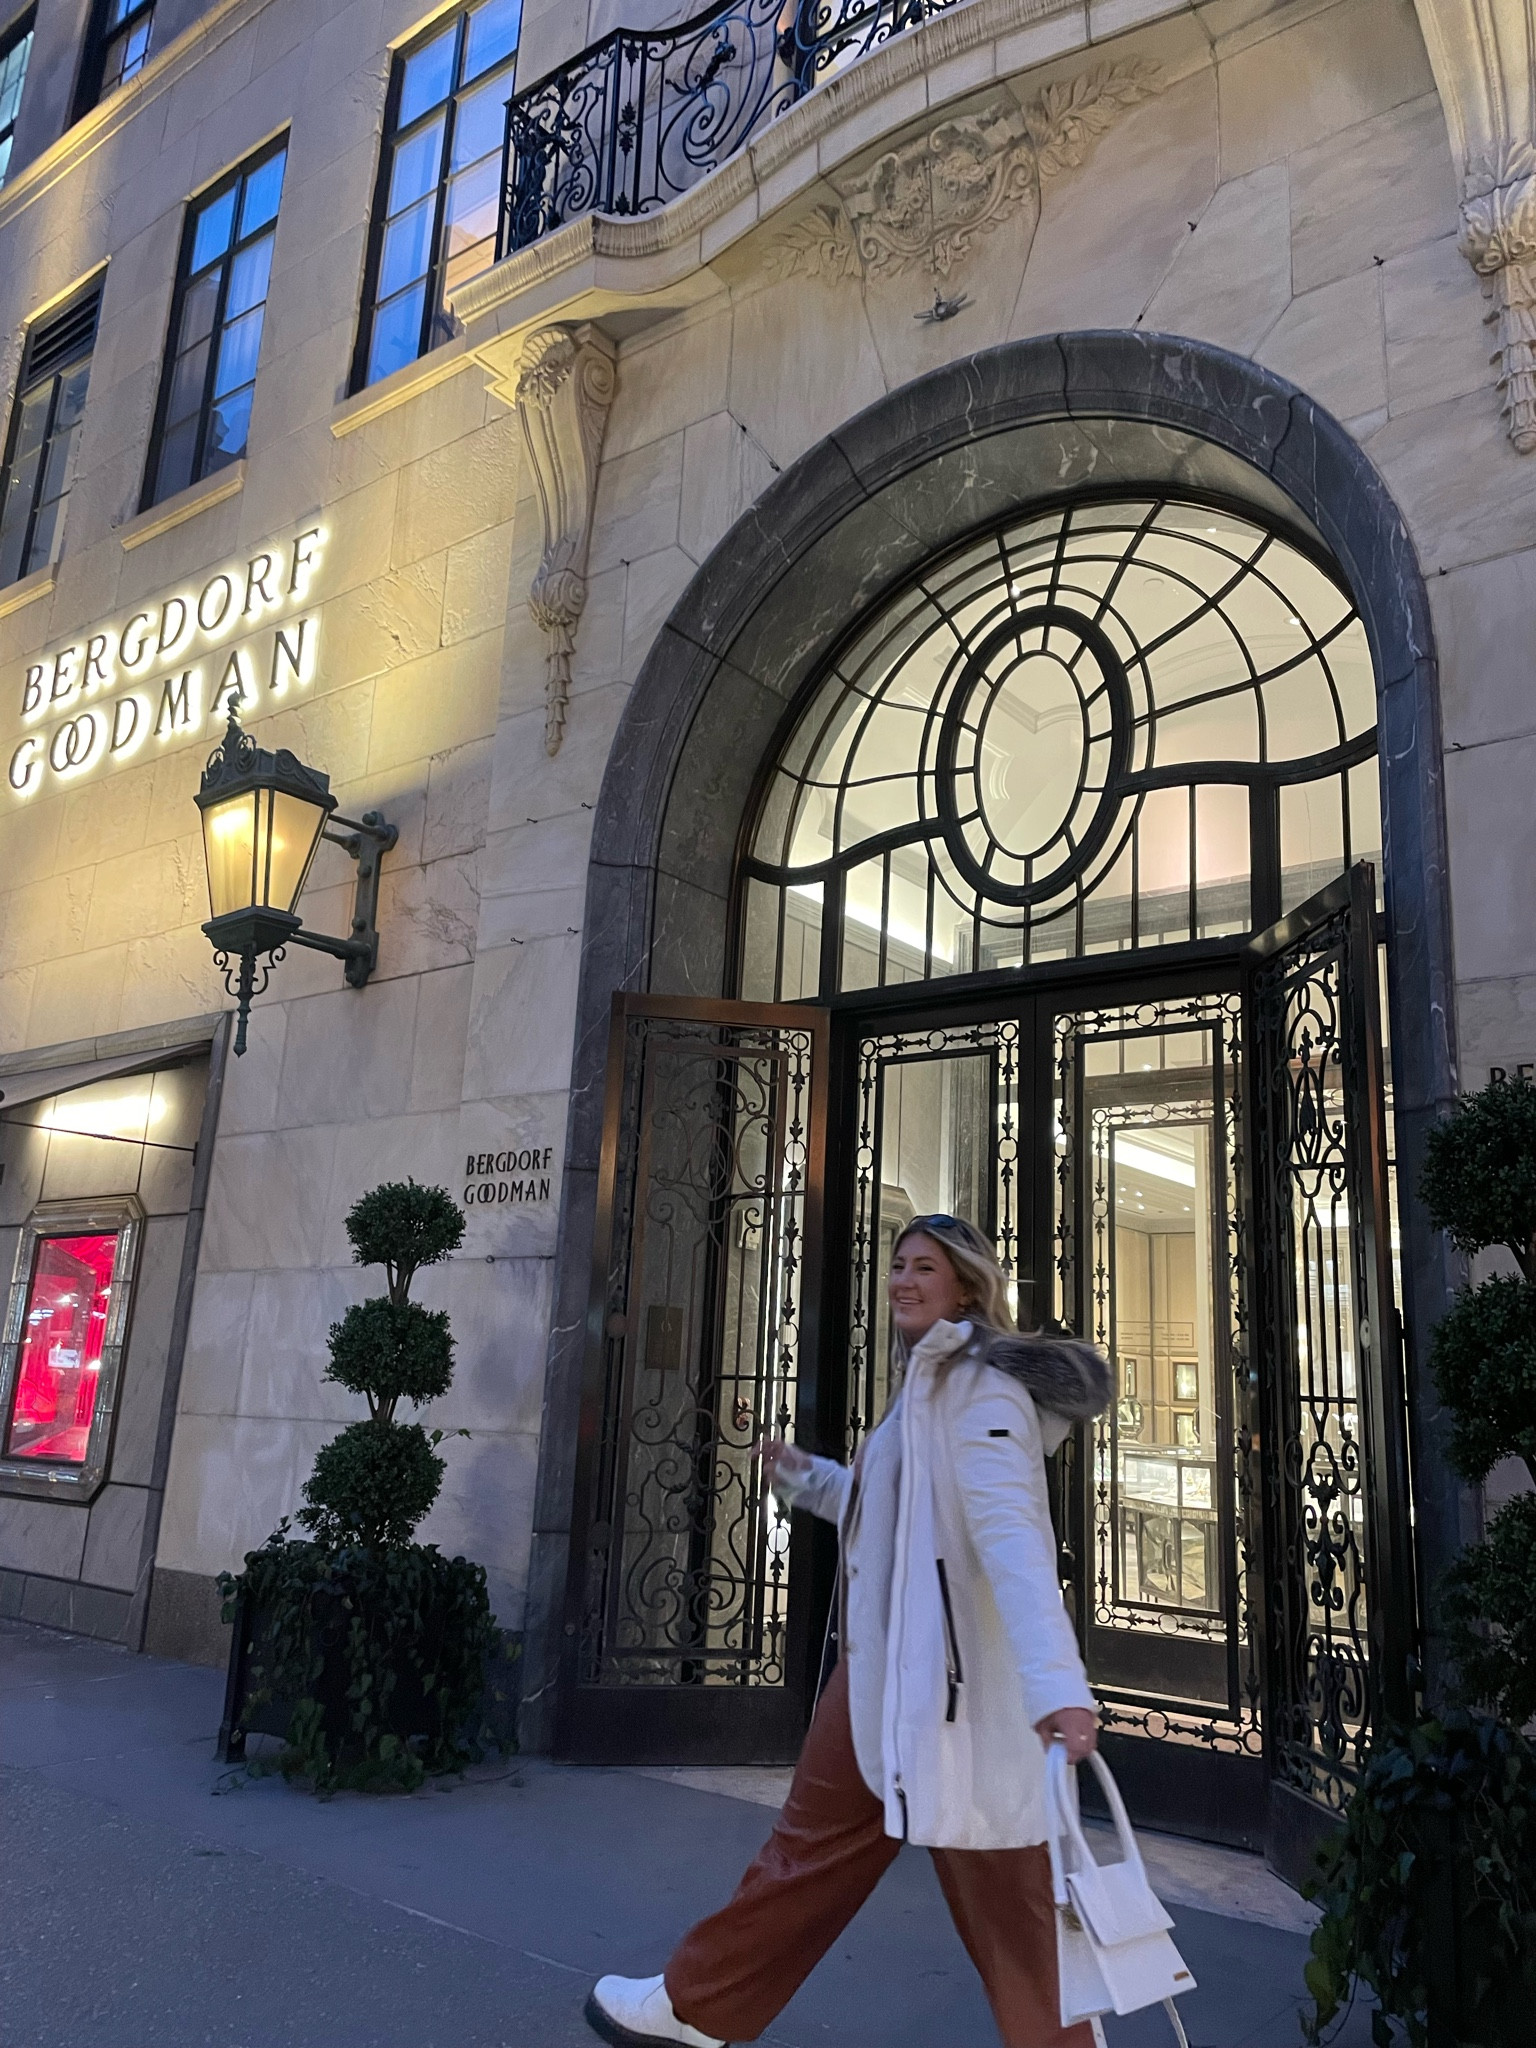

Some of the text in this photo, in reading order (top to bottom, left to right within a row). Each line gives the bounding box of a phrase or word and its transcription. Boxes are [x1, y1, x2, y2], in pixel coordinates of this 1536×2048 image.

[20, 527, 320, 717] BERGDORF
[8, 618, 308, 790] GOODMAN
[463, 1178, 550, 1204] GOODMAN
[466, 1147, 552, 1175] BERGDORF
